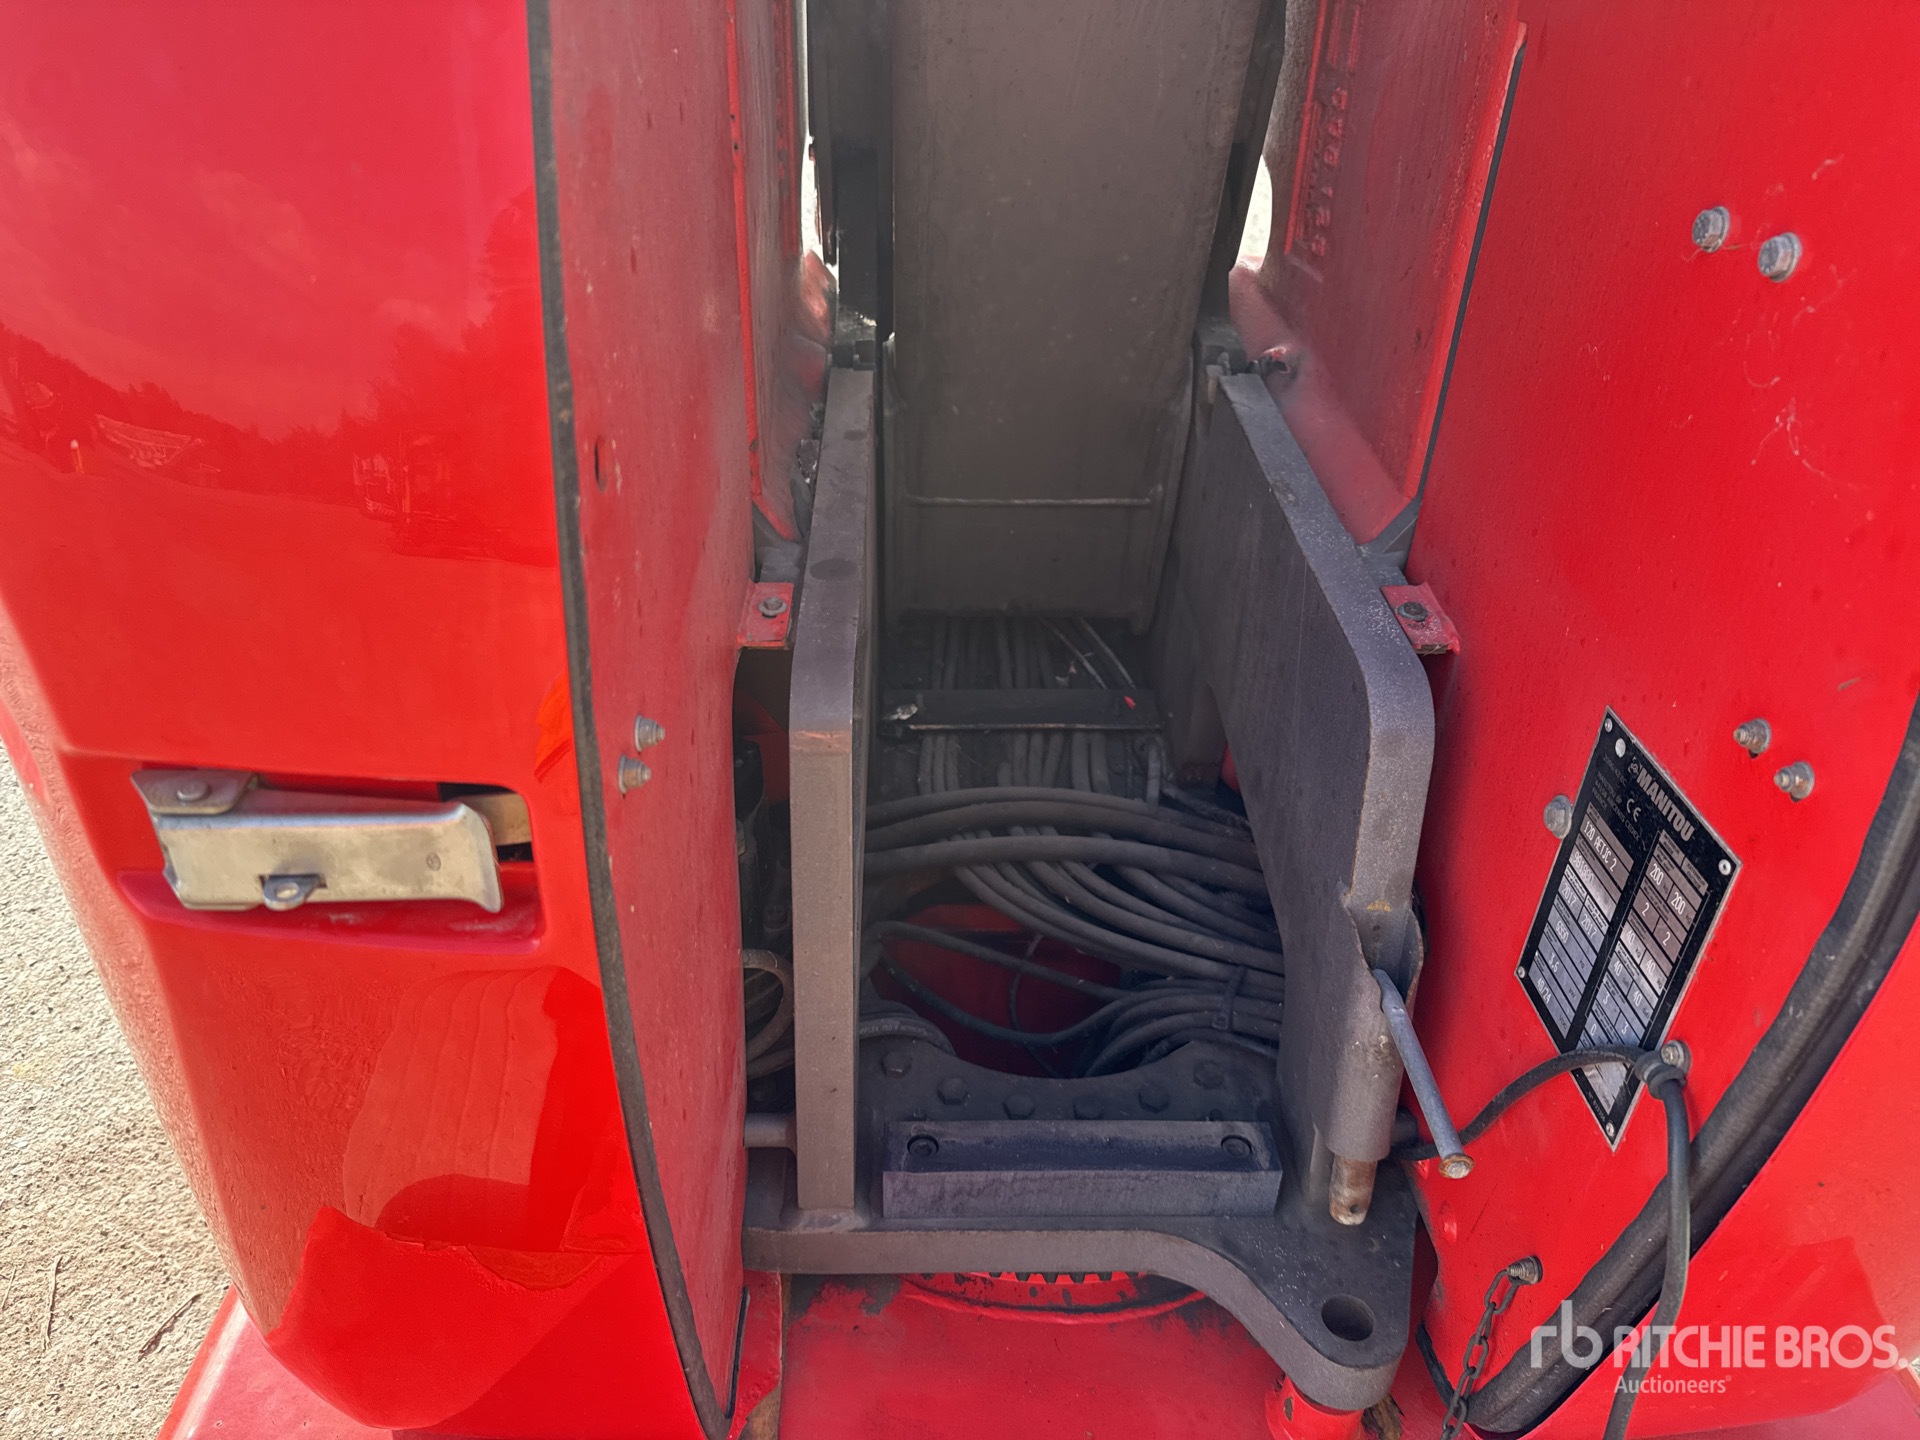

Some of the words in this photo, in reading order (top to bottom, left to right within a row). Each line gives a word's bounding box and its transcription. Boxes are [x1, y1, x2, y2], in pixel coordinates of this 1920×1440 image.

[1637, 768, 1695, 841] MANITOU
[1584, 822, 1596, 841] 120
[1610, 857, 1617, 871] 2
[1650, 864, 1664, 885] 200
[1562, 884, 1576, 907] 2017
[1671, 892, 1686, 915] 200
[1641, 902, 1650, 917] 2
[1581, 914, 1597, 939] 2017
[1625, 929, 1636, 946] 40
[1662, 931, 1671, 946] 2
[1613, 959, 1623, 976] 40
[1645, 958, 1656, 975] 40
[1602, 991, 1610, 1005] 3
[1632, 989, 1643, 1006] 40
[1620, 1021, 1629, 1035] 3
